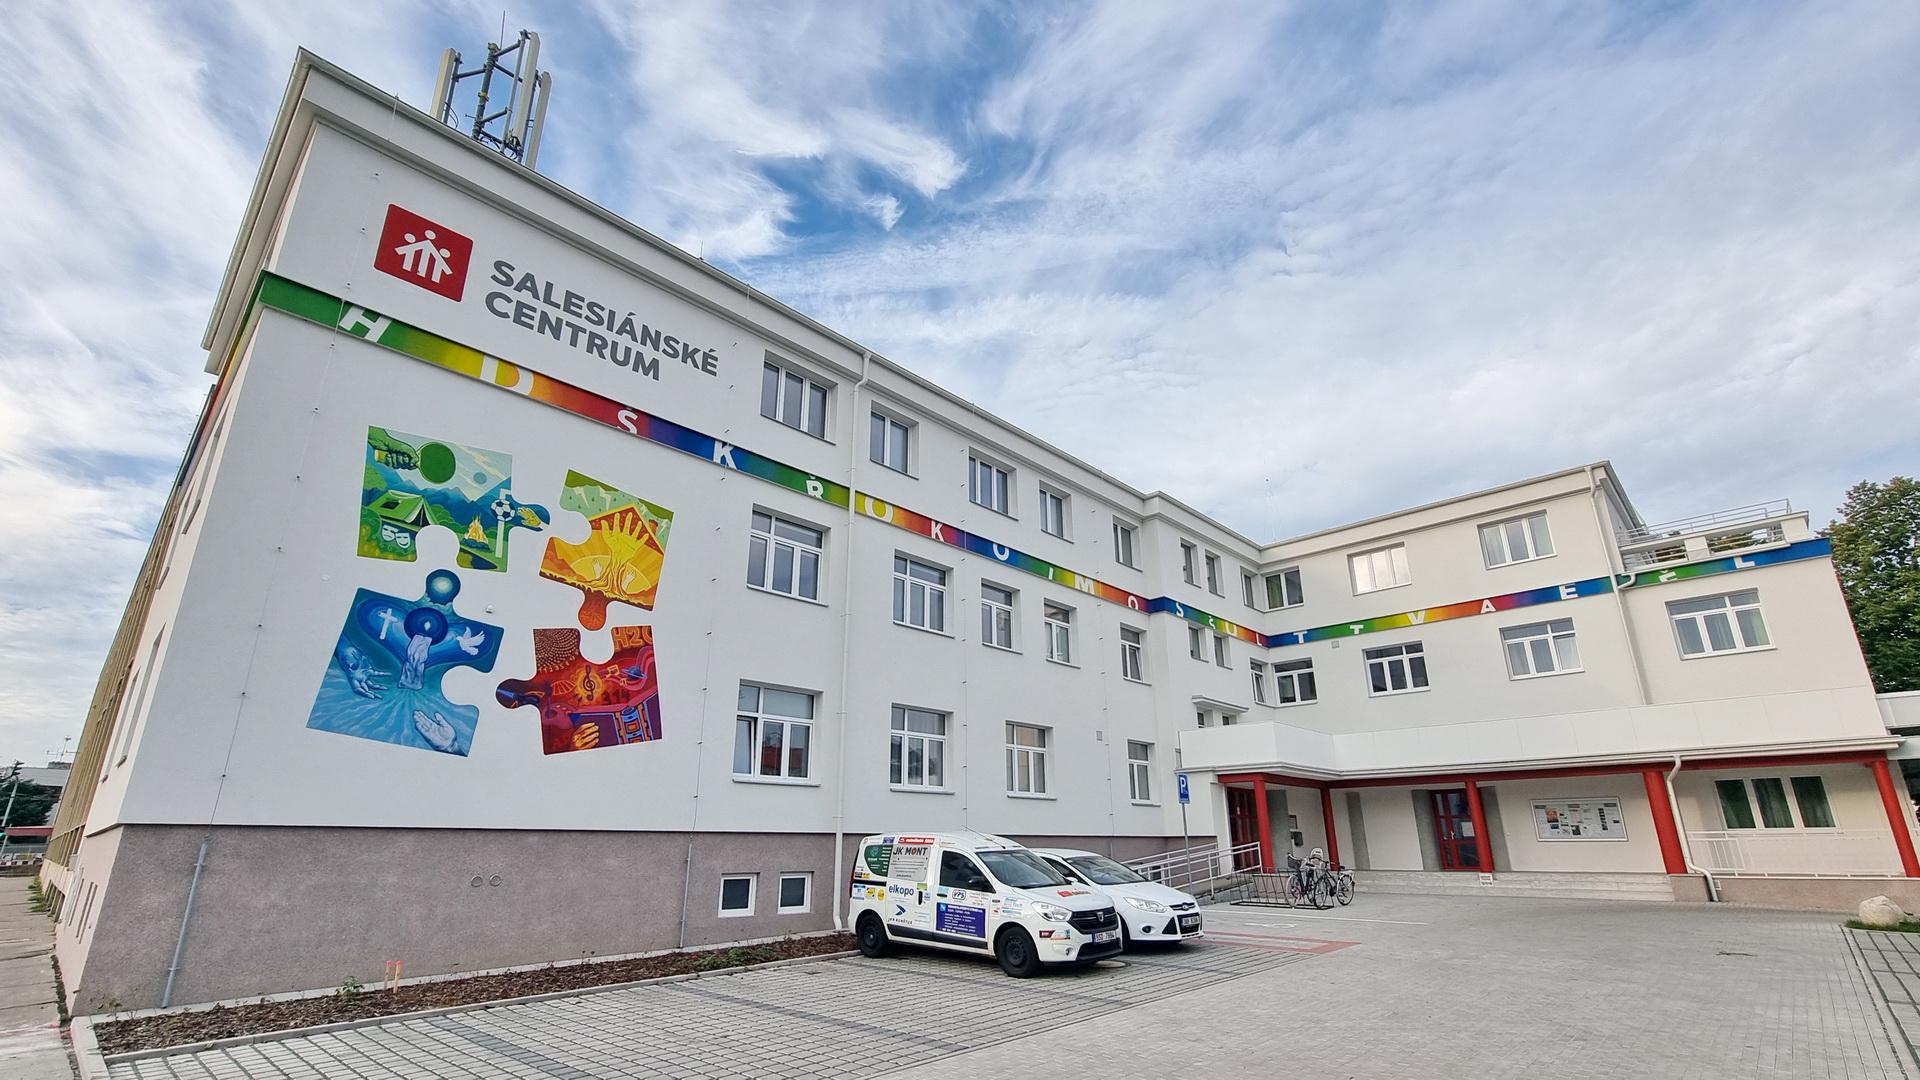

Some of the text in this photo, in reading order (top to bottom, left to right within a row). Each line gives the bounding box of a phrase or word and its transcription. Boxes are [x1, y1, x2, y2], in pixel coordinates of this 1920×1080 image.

[485, 291, 660, 381] CENTRUM
[490, 260, 719, 377] SALESIÁNSKÉ
[339, 305, 393, 343] H
[713, 440, 738, 470] K
[930, 520, 945, 542] K
[1074, 573, 1095, 594] M
[1293, 630, 1308, 643] T
[1350, 624, 1364, 634] T
[1406, 610, 1426, 624] V
[1480, 599, 1496, 613] A
[1558, 583, 1579, 600] E
[1733, 556, 1755, 569] L
[1179, 776, 1186, 794] P
[905, 847, 928, 855] MONT
[888, 885, 914, 897] elkopo
